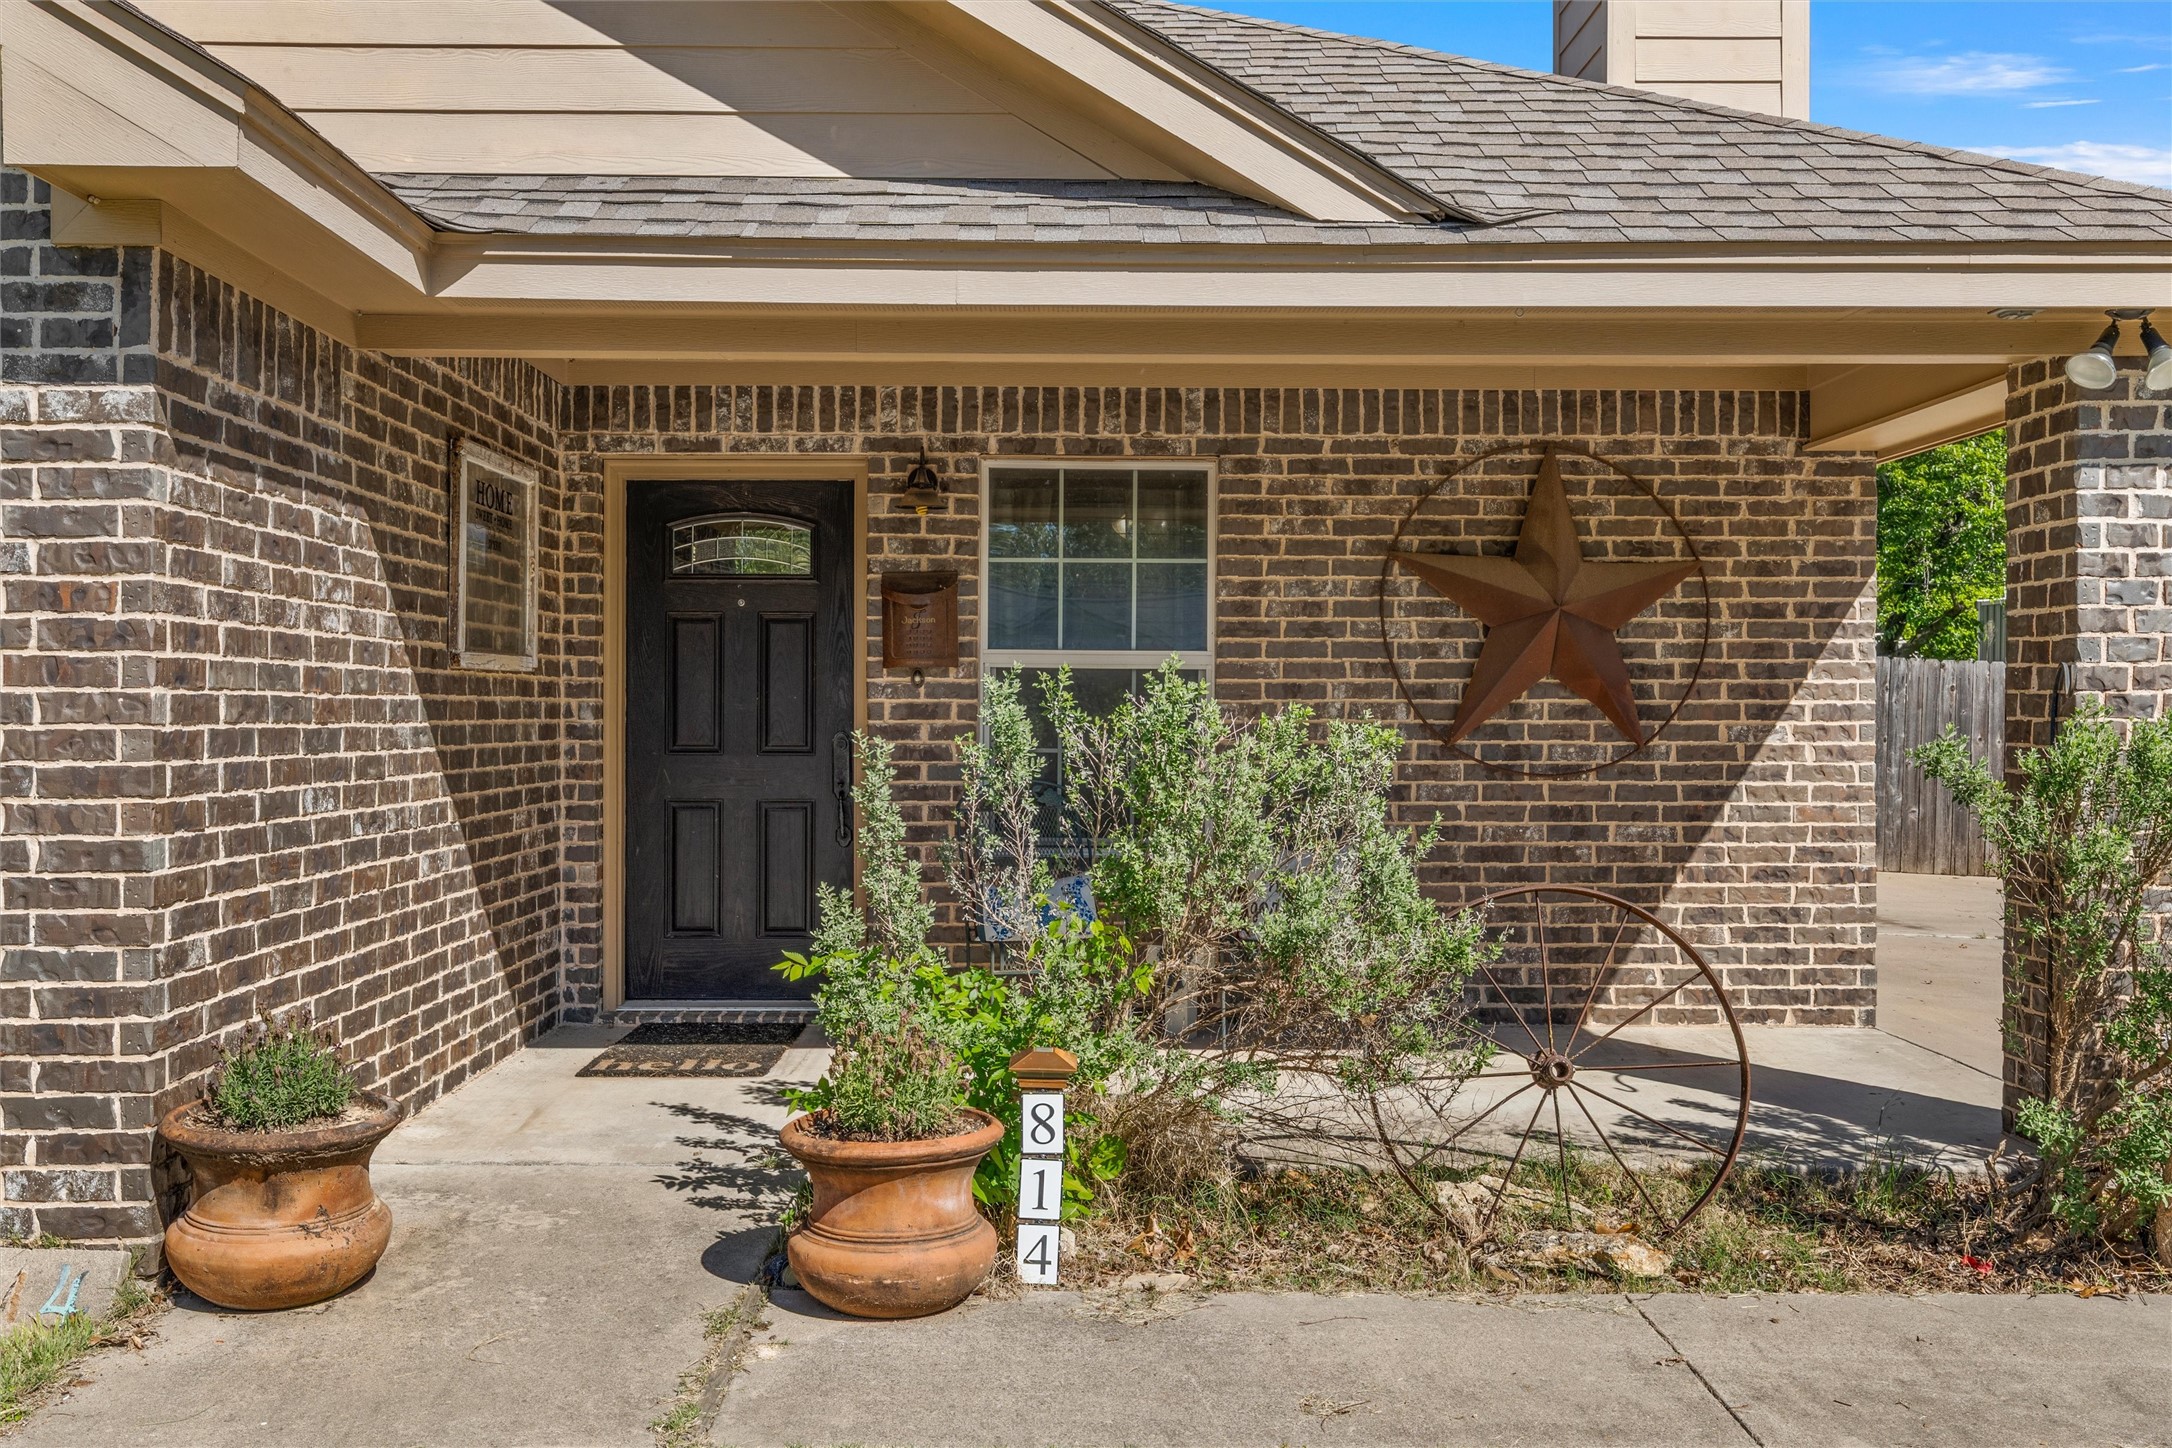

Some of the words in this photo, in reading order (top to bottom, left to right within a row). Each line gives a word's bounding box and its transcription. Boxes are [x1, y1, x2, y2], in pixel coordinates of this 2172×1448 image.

[475, 479, 512, 515] HOME
[475, 507, 492, 523] SWEET
[497, 515, 512, 530] HOME
[901, 616, 936, 625] Jackson
[590, 1058, 762, 1072] hello
